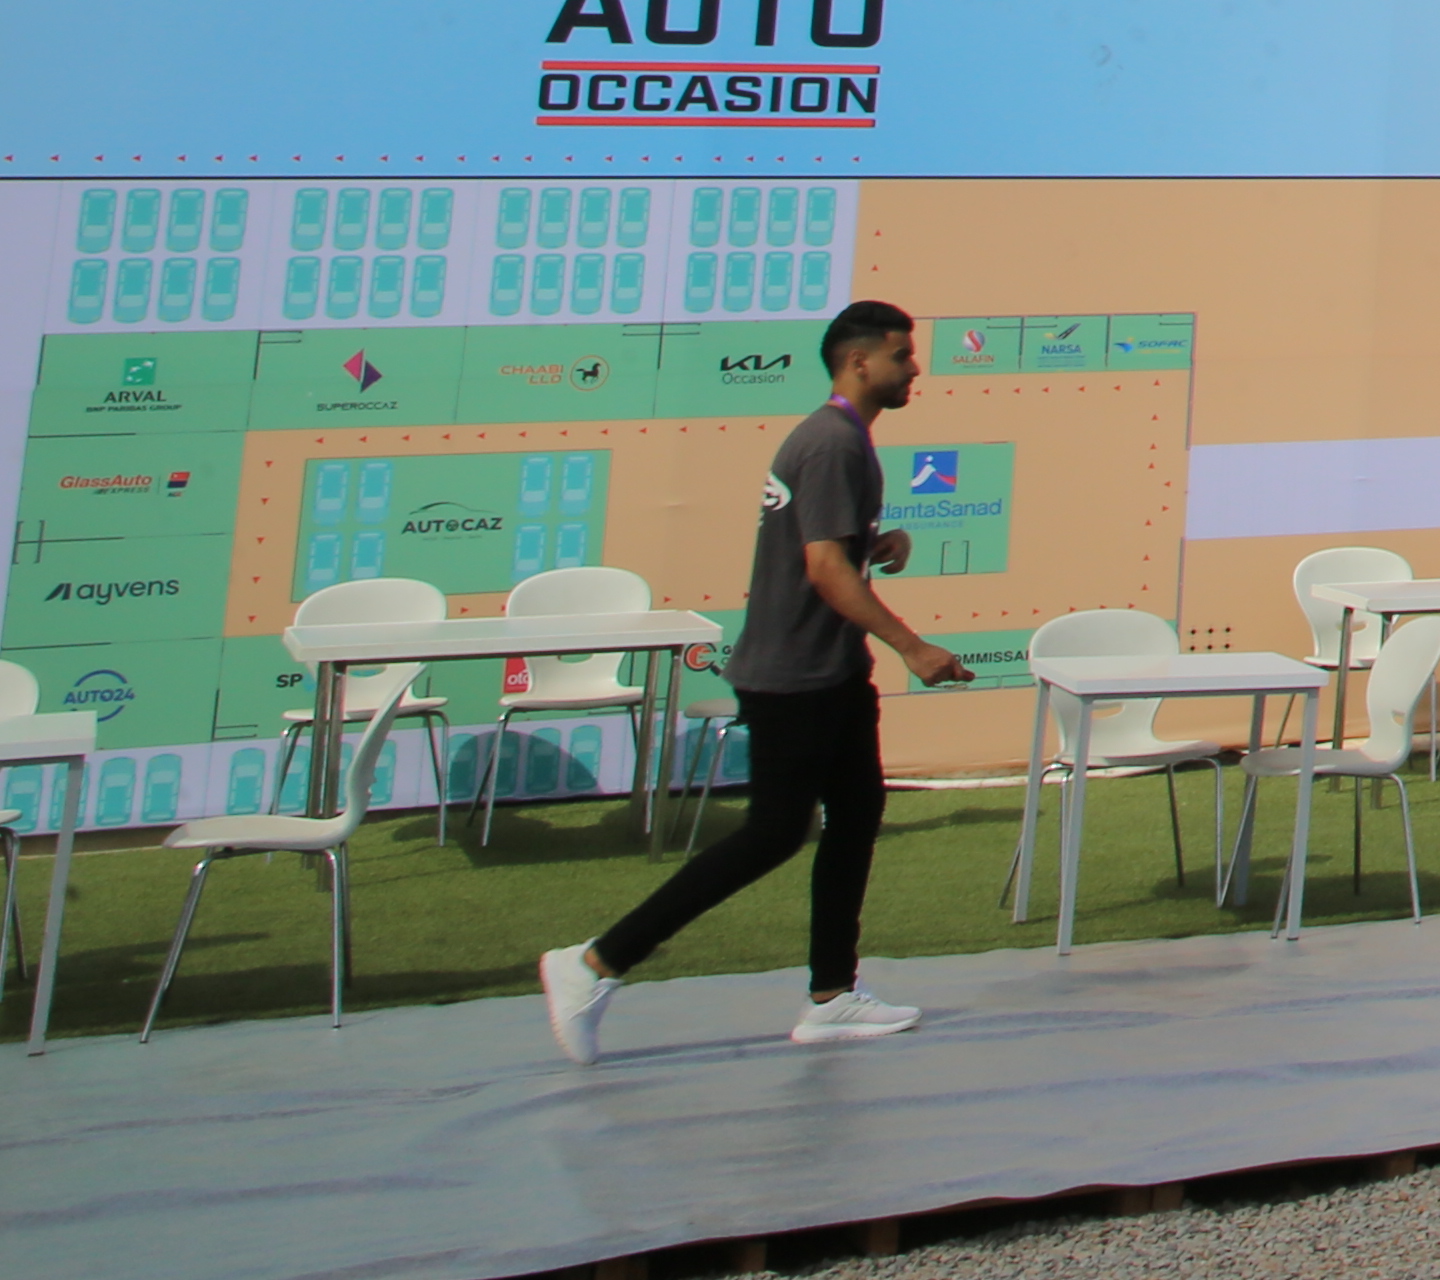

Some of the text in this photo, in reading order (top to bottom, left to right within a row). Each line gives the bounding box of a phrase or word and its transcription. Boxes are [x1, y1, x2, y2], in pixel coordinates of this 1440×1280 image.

[538, 74, 878, 113] OCCASION
[1041, 344, 1082, 355] NARSA
[952, 354, 994, 365] SALAFIN
[499, 364, 564, 376] CHAABI
[528, 374, 562, 385] LLD
[722, 372, 785, 385] Occasion
[104, 390, 167, 403] ARVAL
[316, 401, 398, 412] SUPEROCCAZ
[60, 474, 153, 489] GlassAuto
[879, 498, 1003, 521] tlantaSanad
[76, 578, 180, 605] ayvens
[63, 688, 135, 704] AUTO24
